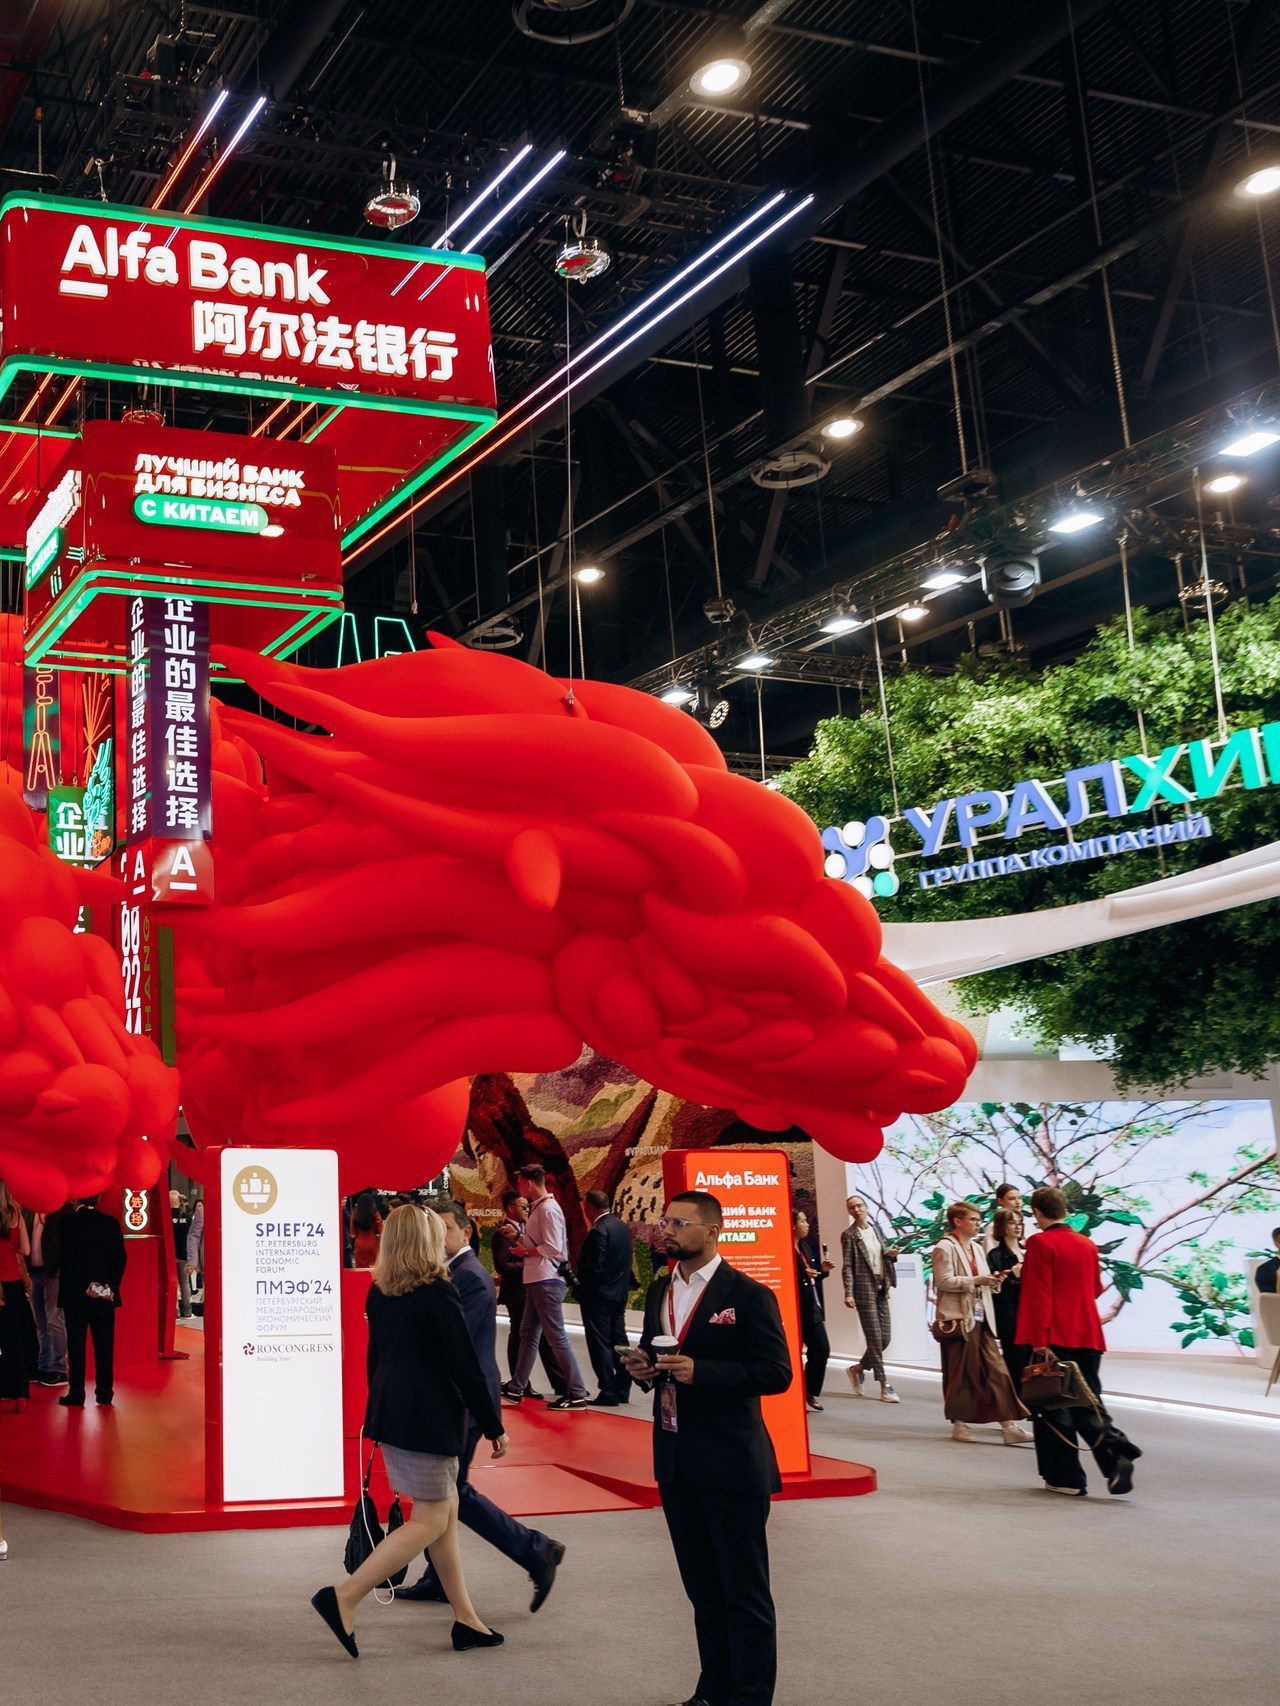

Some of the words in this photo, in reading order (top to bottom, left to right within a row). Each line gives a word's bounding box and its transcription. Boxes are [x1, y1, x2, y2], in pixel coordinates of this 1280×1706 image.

[61, 224, 179, 285] Alfa
[189, 239, 331, 305] Bank
[193, 301, 458, 381] 阿尔法银行
[135, 454, 239, 482] ЛУЧШИЙ
[243, 464, 306, 489] БАНК
[135, 474, 187, 496] ДЛЯ
[190, 479, 302, 507] БИЗНЕСА
[141, 500, 156, 516] С
[163, 501, 259, 527] КИТАЕМ
[131, 596, 147, 834] 企业的最佳选择
[164, 597, 199, 829] 企业的最佳选择
[56, 802, 84, 866] 企业
[169, 846, 197, 876] A
[919, 852, 1024, 890] ГРУППА
[1028, 812, 1212, 869] КОМПАНИЙ
[133, 850, 146, 878] A
[695, 1171, 742, 1189] Альфа
[744, 1171, 779, 1186] Банк
[722, 1205, 746, 1216] ШИЙ
[748, 1207, 777, 1216] БАНК
[256, 1223, 325, 1238] SPIEF'24
[724, 1219, 773, 1229] БИЗНЕСА
[268, 1240, 318, 1248] PETERSBURG
[718, 1232, 756, 1242] ИТАЕМ
[256, 1280, 332, 1295] ПМЭФ'24
[256, 1297, 322, 1305] ПЕТЕРБУРГСКИЙ
[256, 1305, 333, 1314] МЕЖДУНАРОДНЫЙ
[256, 1314, 331, 1323] ЭКОНОМИЧЕСКИЙ
[257, 1343, 334, 1354] ROSCONGRESS
